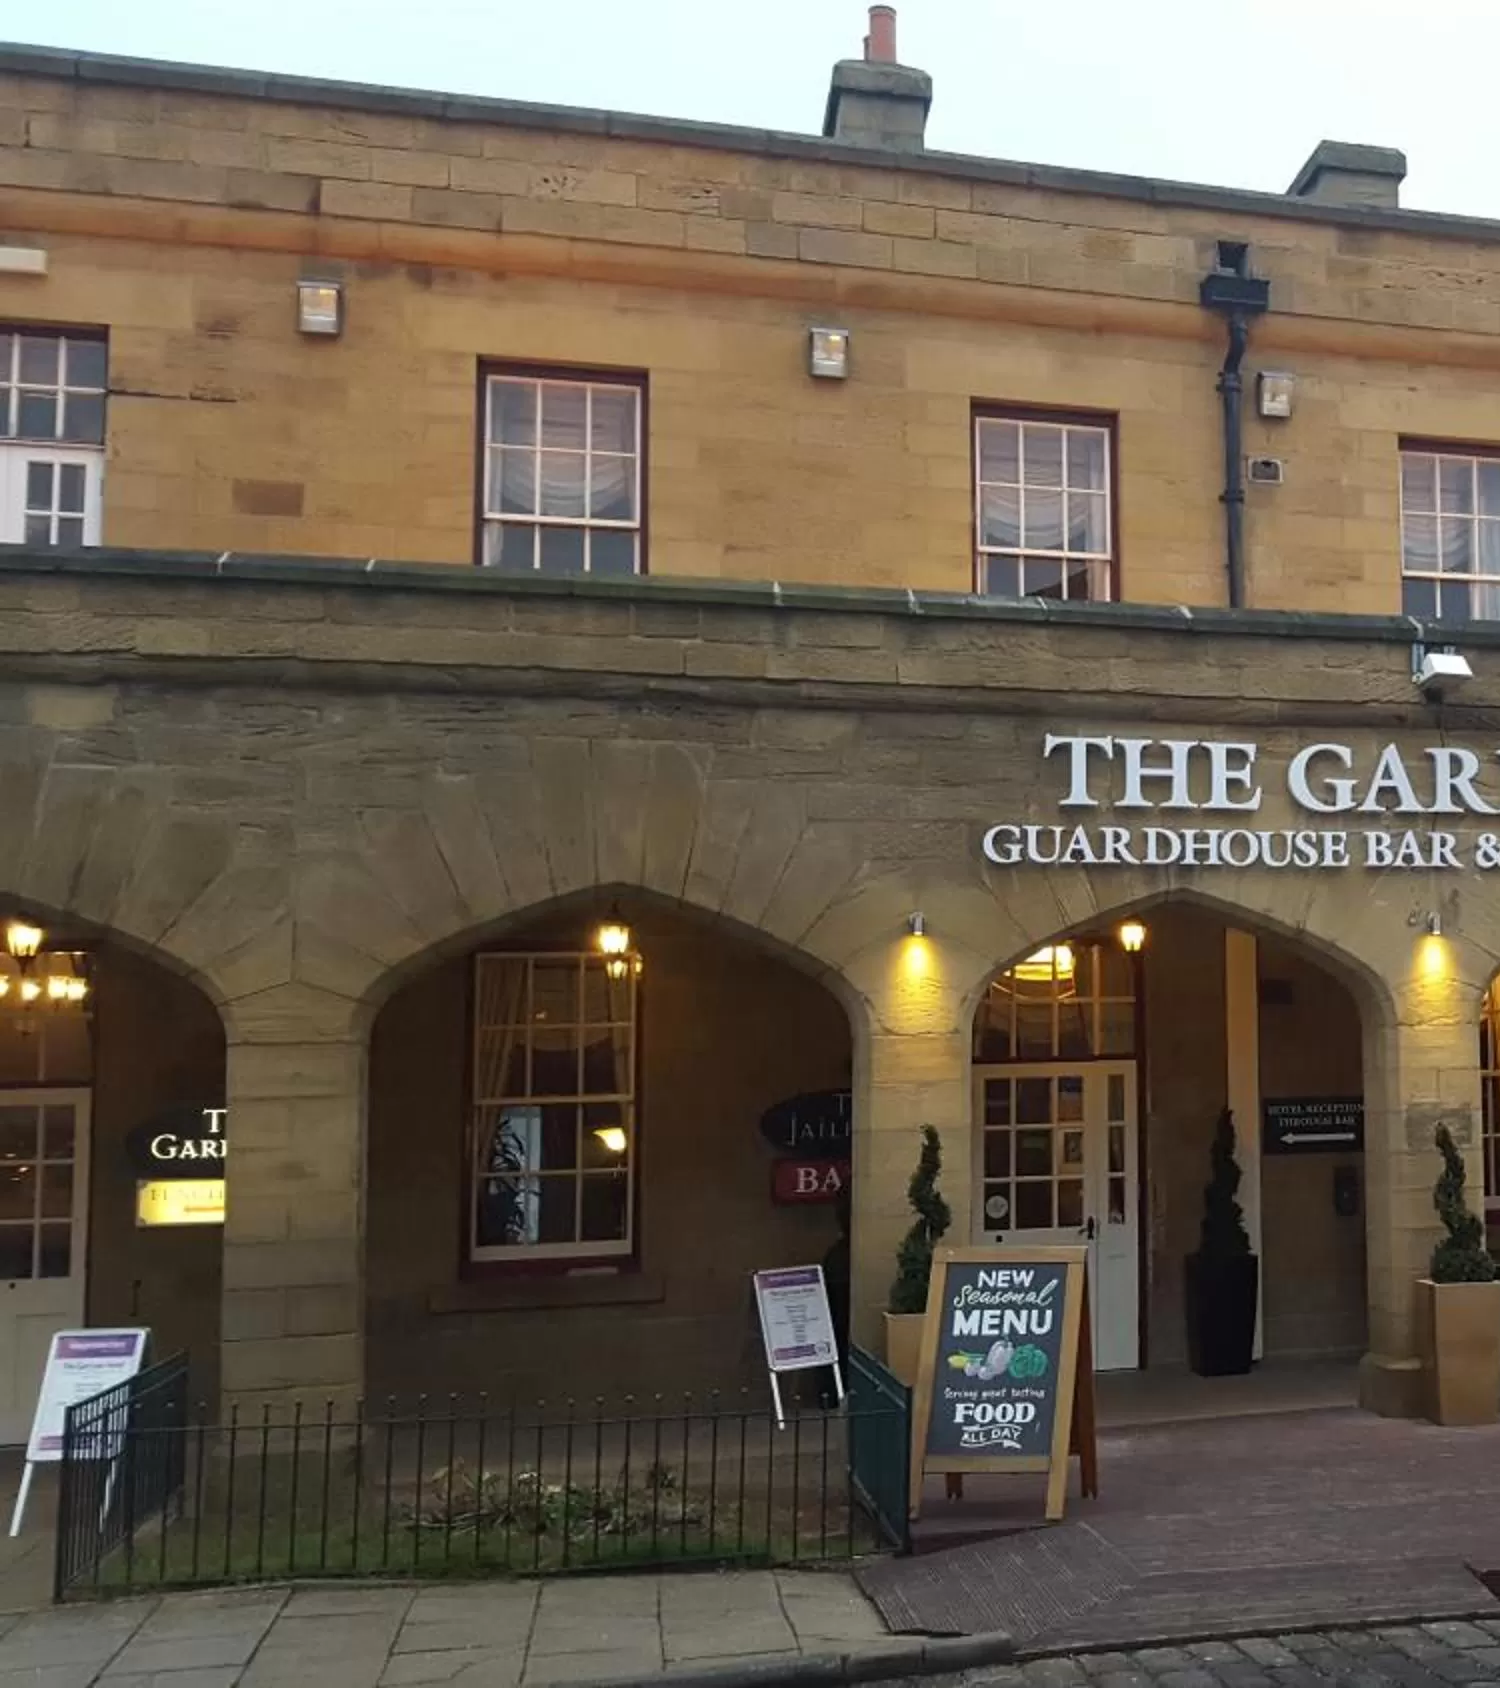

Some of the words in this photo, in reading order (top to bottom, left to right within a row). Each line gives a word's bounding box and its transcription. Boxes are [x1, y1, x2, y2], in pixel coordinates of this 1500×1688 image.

[1043, 733, 1262, 811] THE
[983, 824, 1350, 867] GUARDHOUSE
[1364, 831, 1463, 868] BAR
[793, 1166, 842, 1193] BA
[977, 1270, 1035, 1288] NEW
[953, 1279, 1059, 1307] Seasonal
[952, 1309, 1053, 1337] MENU
[953, 1403, 1035, 1424] FOOD
[961, 1430, 988, 1442] ALL
[991, 1426, 1022, 1441] DAY
